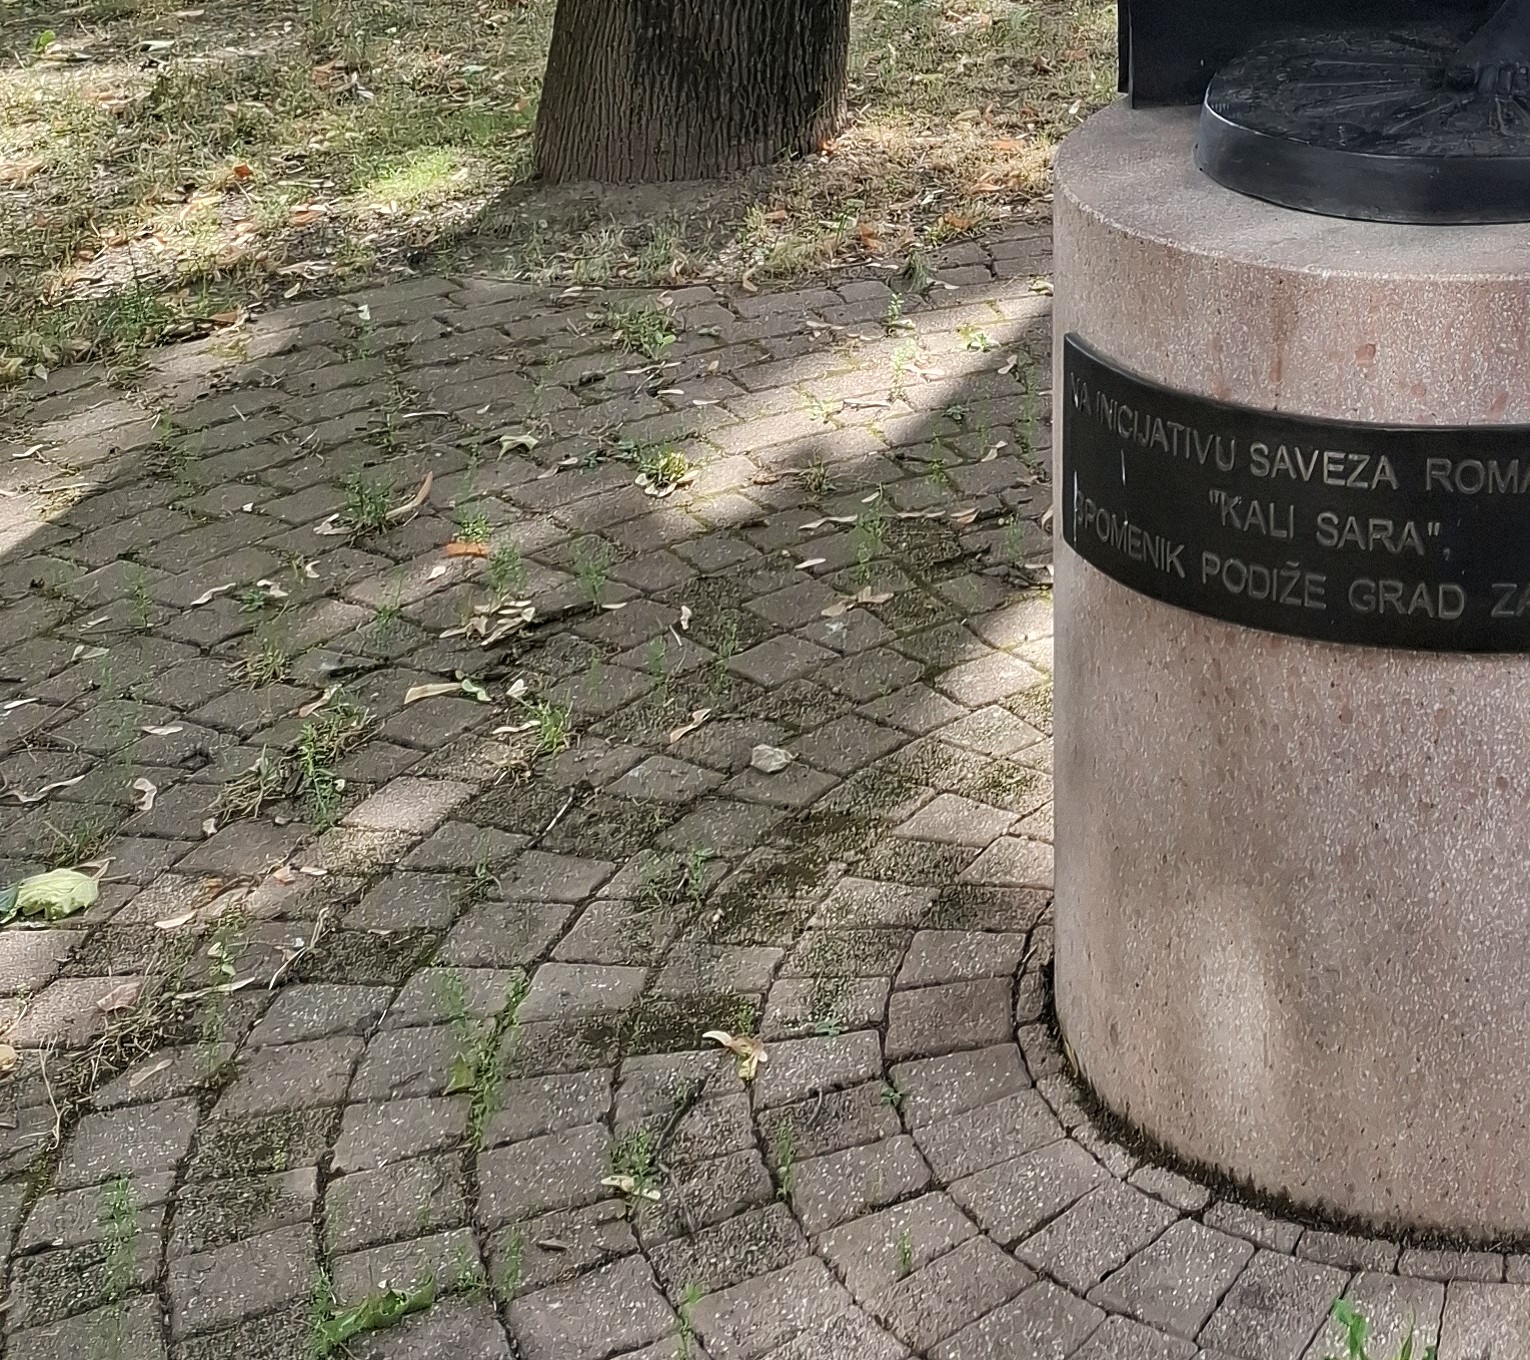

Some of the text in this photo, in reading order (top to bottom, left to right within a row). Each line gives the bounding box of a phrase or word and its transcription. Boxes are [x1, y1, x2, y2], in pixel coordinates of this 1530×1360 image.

[1096, 390, 1237, 471] INICIJATIVU
[1249, 442, 1399, 491] SAVEZA
[1208, 487, 1295, 540] "KALI
[1202, 550, 1327, 610] PODIŽE
[1348, 576, 1467, 621] GRAD
